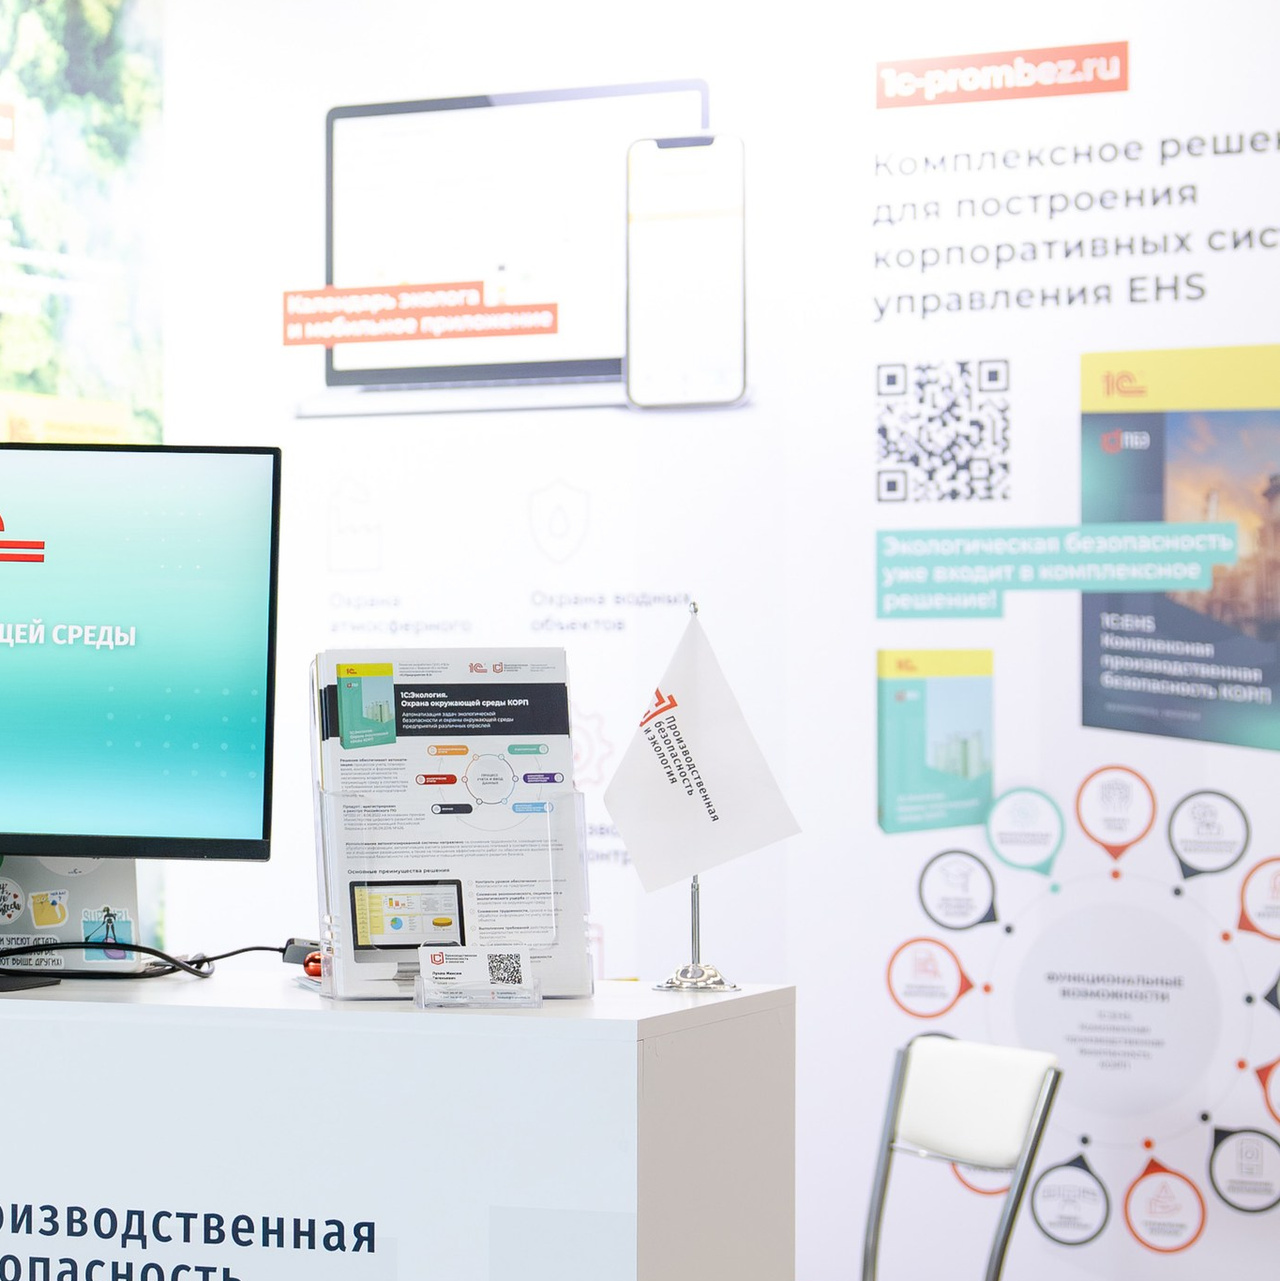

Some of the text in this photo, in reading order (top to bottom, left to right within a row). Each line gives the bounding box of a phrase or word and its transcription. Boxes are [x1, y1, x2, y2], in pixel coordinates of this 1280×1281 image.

[879, 55, 1121, 101] 1c-prombez.ru
[874, 129, 1280, 177] Комплексное реше
[872, 182, 1199, 228] для построения
[874, 229, 1194, 274] корпоративных
[873, 272, 1208, 323] управления EHS
[882, 531, 1235, 558] Экологическая безопасность
[1038, 561, 1203, 583] комплексное
[51, 625, 138, 650] СРЕДЫ
[431, 699, 480, 709] окружающей
[482, 699, 506, 708] среды
[644, 727, 678, 785] и экология
[654, 720, 694, 797] безопасность
[665, 715, 719, 822] Производственная
[5, 936, 30, 946] УМЕЮТ
[12, 958, 33, 966] ВЫШЕ
